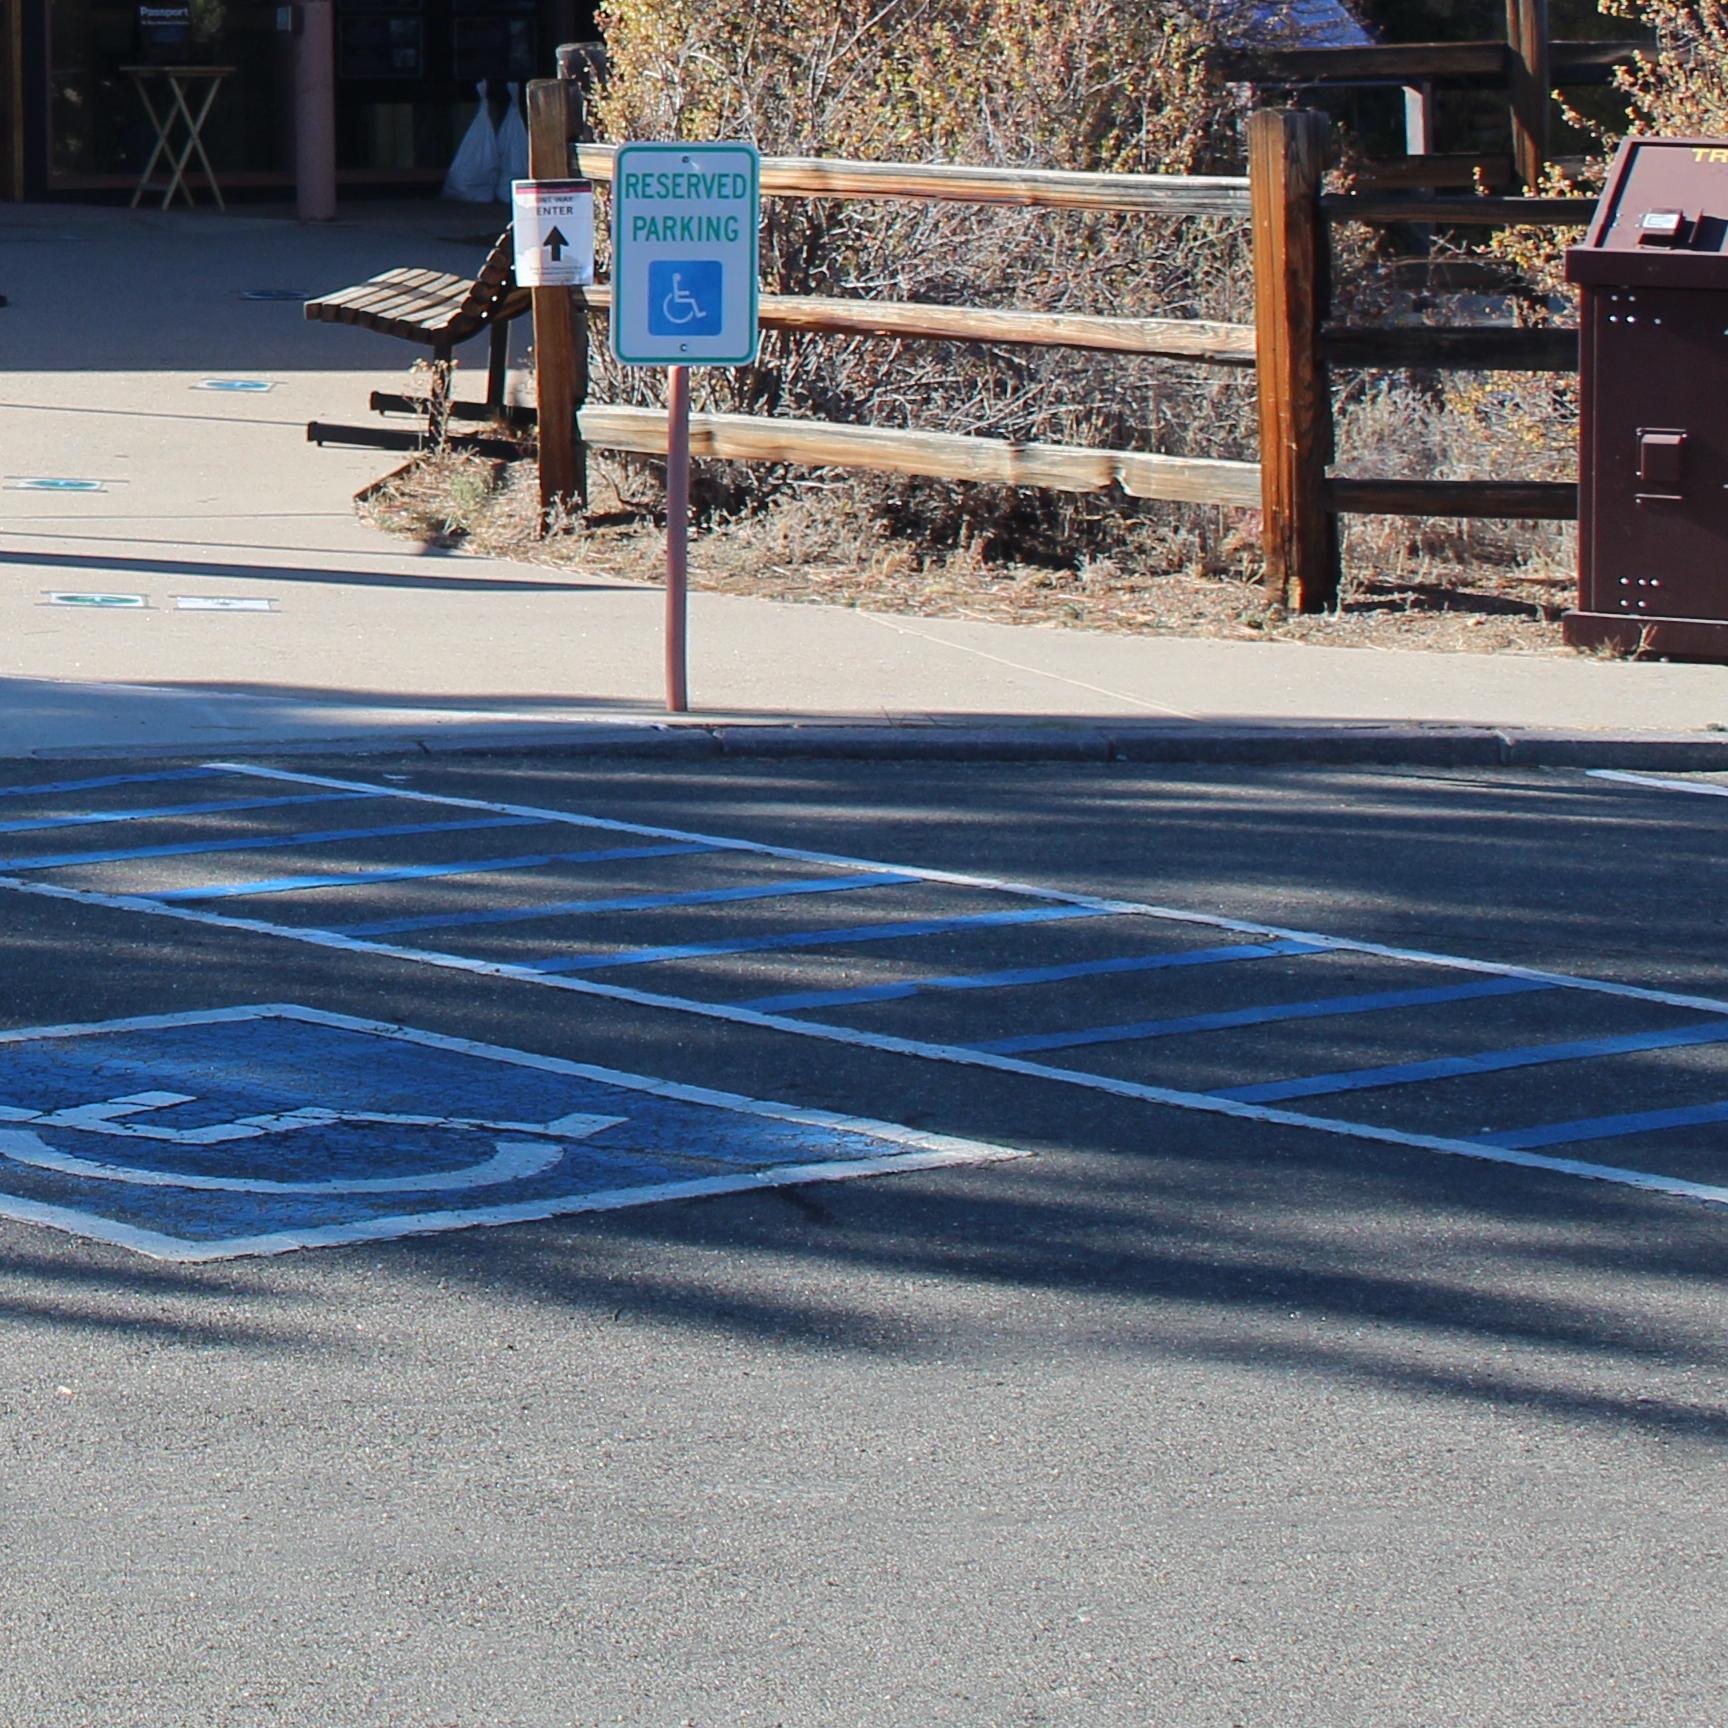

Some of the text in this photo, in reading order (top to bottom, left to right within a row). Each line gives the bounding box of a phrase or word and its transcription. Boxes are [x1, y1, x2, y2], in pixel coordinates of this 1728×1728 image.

[625, 173, 747, 200] RESERVED
[536, 206, 575, 216] ENTER
[632, 215, 739, 242] PARKING
